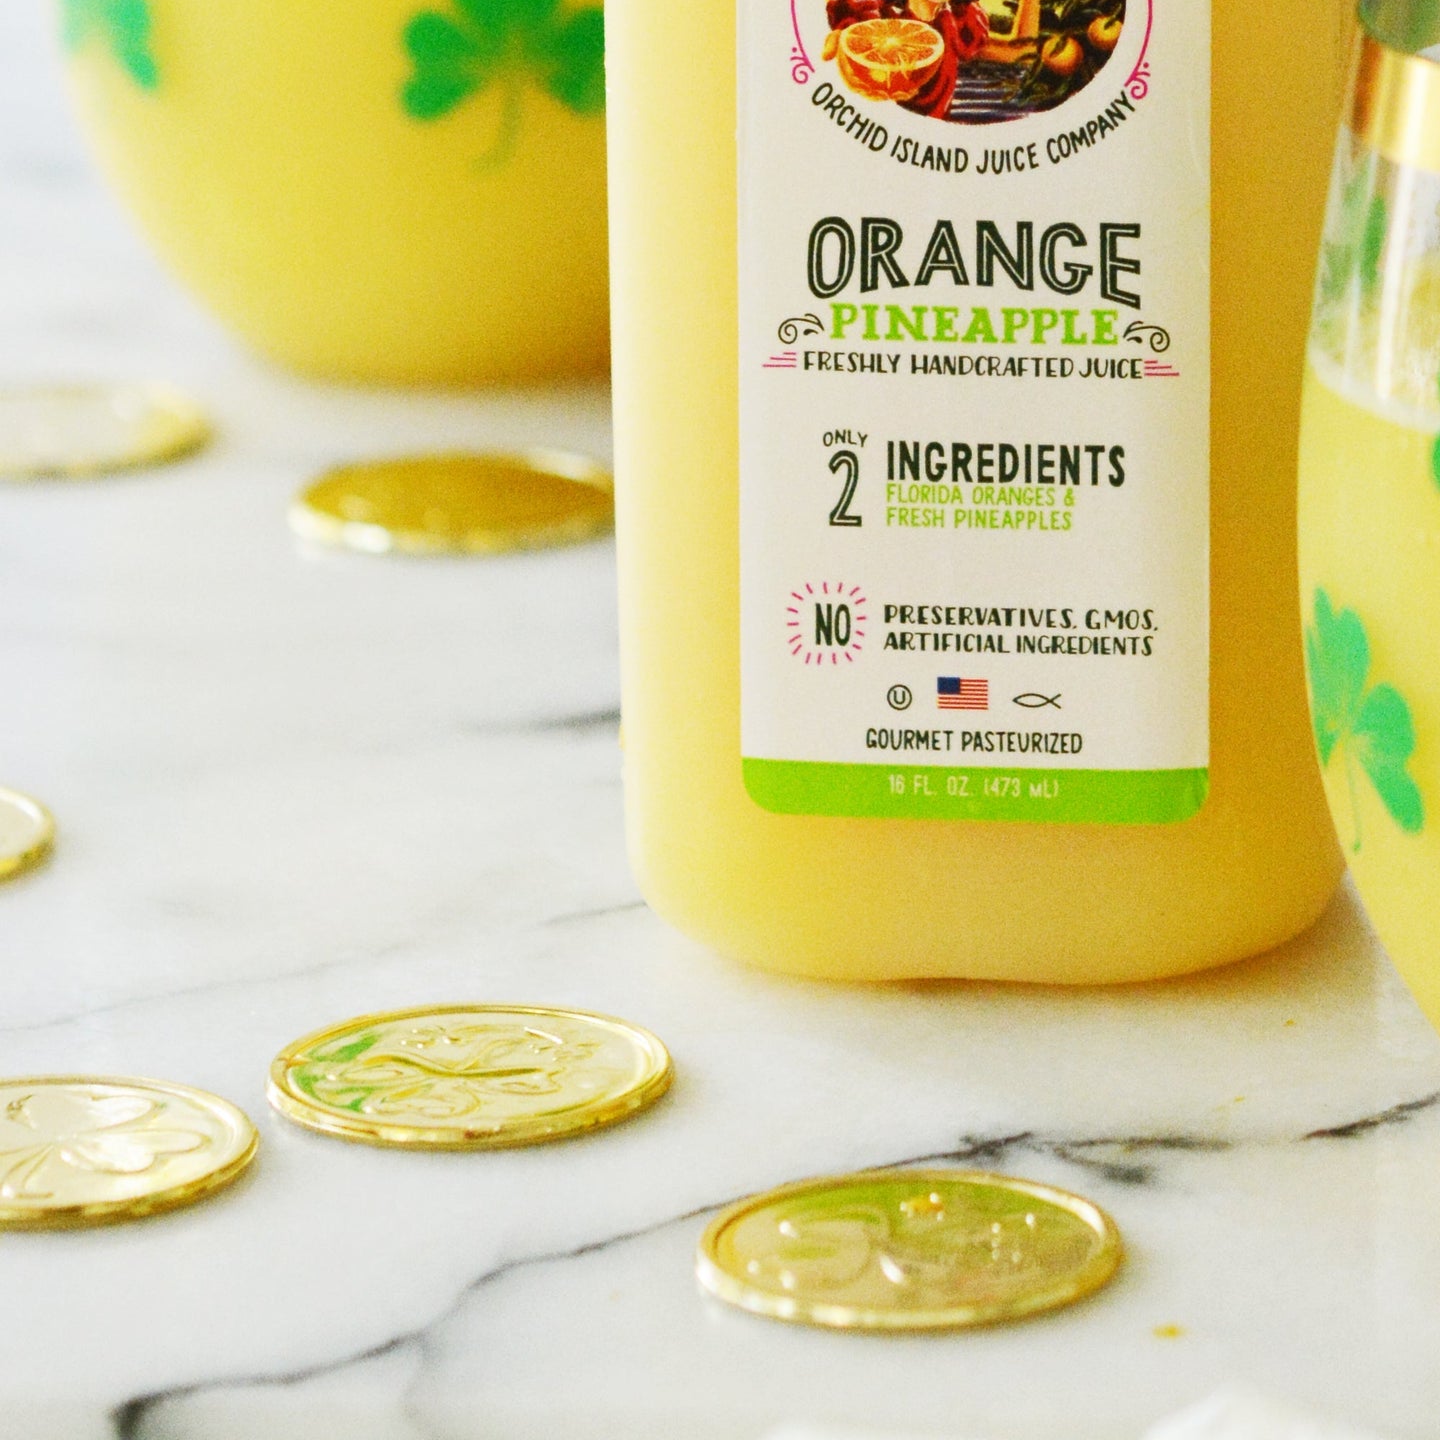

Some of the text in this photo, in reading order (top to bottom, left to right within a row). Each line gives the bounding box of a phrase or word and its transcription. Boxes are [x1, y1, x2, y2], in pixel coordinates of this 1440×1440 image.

[811, 82, 1136, 175] ORCHID ISLAND JUICE COMPANY
[807, 216, 1142, 309] ORANGE
[829, 303, 1119, 345] PINEAPPLE
[803, 351, 1143, 379] FRESHLY HANDCRAFTED JUICE
[823, 429, 868, 447] ONLY
[887, 440, 1125, 487] INGREDIENTS
[828, 450, 862, 527] 2
[886, 484, 1075, 507] FLORIDA ORANGES &
[886, 507, 1072, 531] FRESH PINEAPPLES
[815, 603, 851, 646] NO
[883, 631, 1154, 656] ARTIFICIAL INGREDIENTS
[866, 728, 1082, 754] GOURMET PASTEURIZED
[888, 774, 905, 795] 16
[914, 775, 937, 796] FL.
[984, 777, 1021, 798] (473
